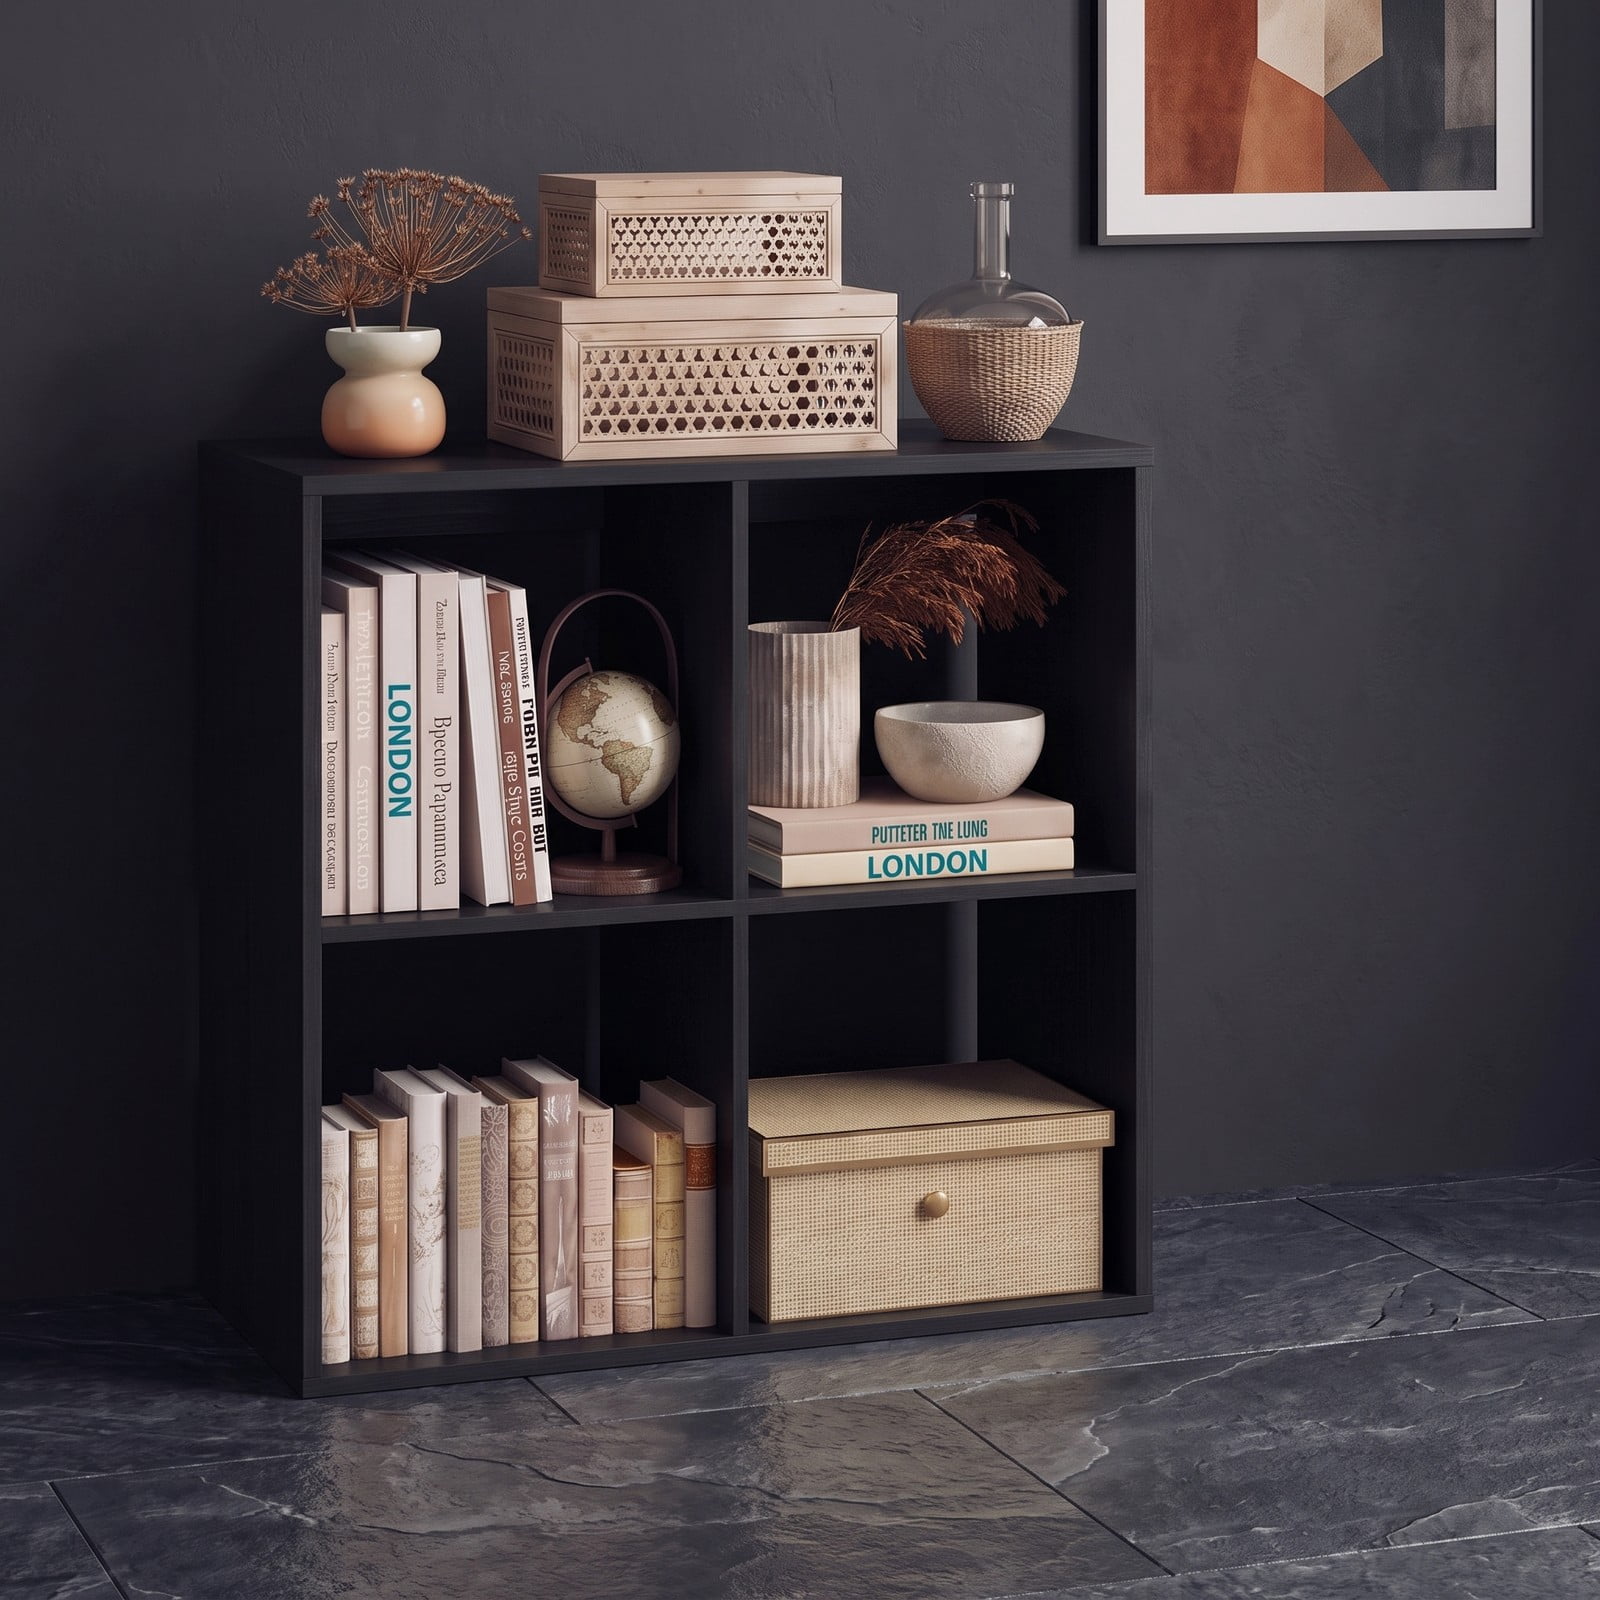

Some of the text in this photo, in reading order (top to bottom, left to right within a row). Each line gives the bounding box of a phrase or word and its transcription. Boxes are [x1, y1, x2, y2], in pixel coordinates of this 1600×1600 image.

[388, 684, 412, 817] LONDON
[532, 824, 547, 853] BUT
[872, 823, 928, 844] PUTTETER
[957, 819, 988, 838] LUNG
[868, 849, 988, 879] LONDON
